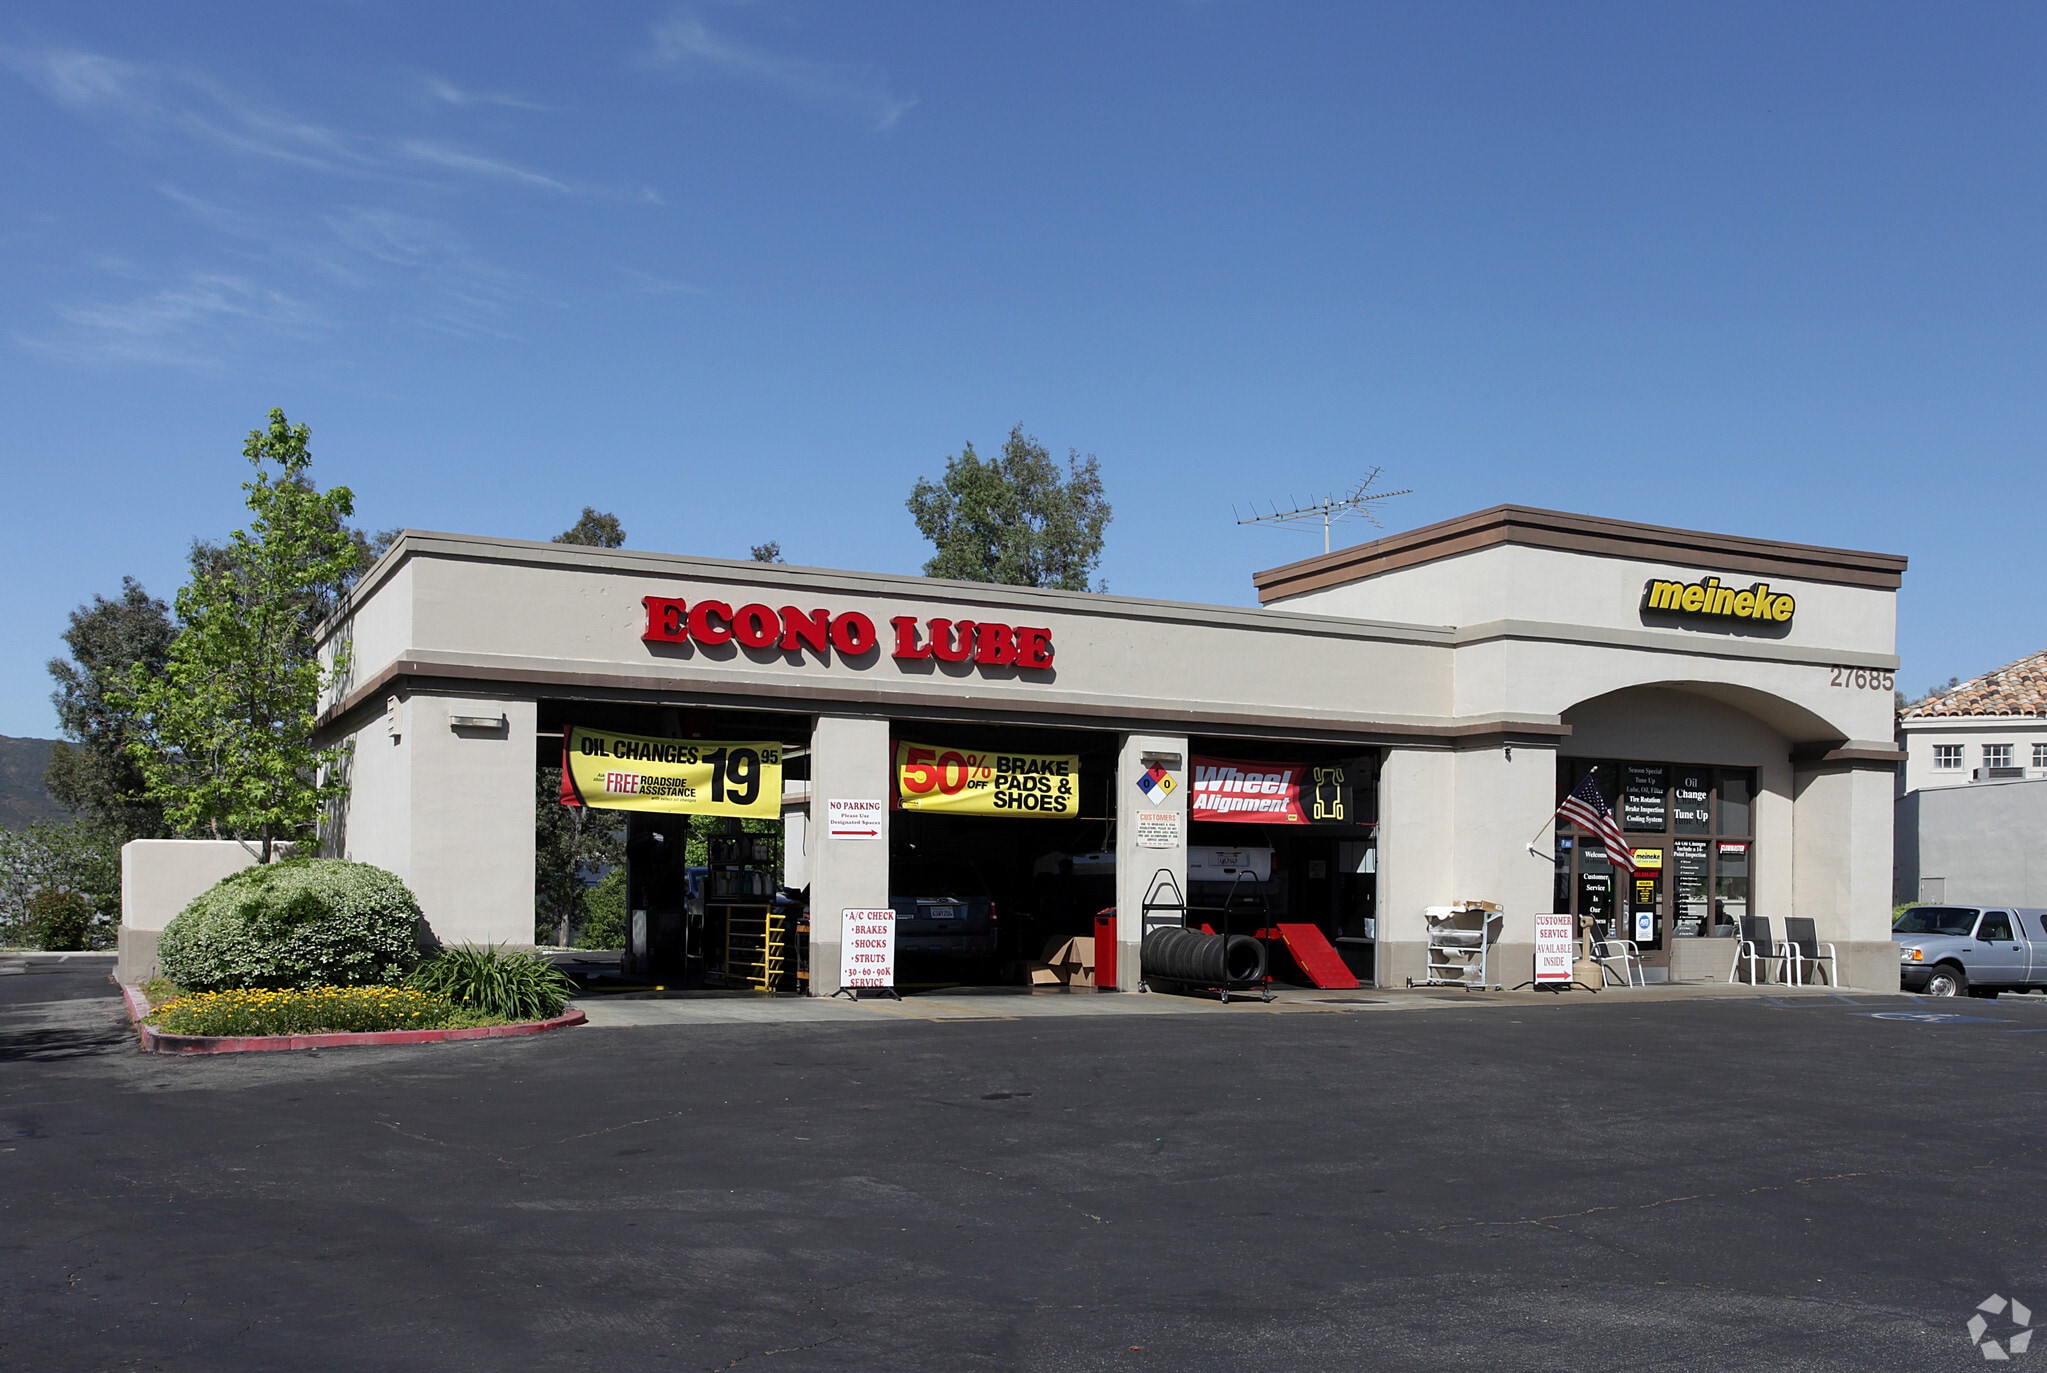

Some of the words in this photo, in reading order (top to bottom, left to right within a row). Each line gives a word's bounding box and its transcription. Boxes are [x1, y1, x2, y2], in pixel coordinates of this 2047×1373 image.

[1647, 577, 1795, 622] meineke
[642, 596, 877, 655] ECONO
[891, 616, 1054, 669] LUBE
[1830, 665, 1894, 691] 27685
[581, 737, 609, 758] OIL
[613, 739, 699, 765] CHANGES
[702, 747, 761, 805] 19
[761, 750, 779, 764] 95
[903, 747, 991, 795] 50%
[996, 756, 1070, 777] BRAKE
[1154, 767, 1159, 777] 1
[606, 772, 639, 794] FREE
[640, 775, 687, 787] ROADSIDE
[967, 780, 989, 790] OFF
[994, 774, 1051, 793] PADS
[1057, 777, 1073, 795] &
[1143, 779, 1150, 788] 0
[1164, 779, 1171, 788] 0
[1194, 765, 1293, 795] Wheel
[1648, 777, 1656, 785] Up
[1685, 778, 1698, 788] Oil
[639, 785, 696, 797] ASSISTANCE
[1676, 788, 1707, 801] Change
[1193, 793, 1290, 813] Alignment
[1629, 795, 1640, 803] Tire
[830, 801, 842, 810] NO
[843, 802, 880, 810] PARKING
[1640, 806, 1665, 814] Inspection
[1140, 813, 1176, 821] CUSTOMERS
[1626, 815, 1645, 823] Cooling
[1673, 809, 1694, 819] Tune
[1696, 810, 1709, 822] Up
[849, 911, 864, 921] A/C
[867, 911, 894, 920] CHECK
[1536, 916, 1572, 925] CUSTOMER
[855, 925, 888, 934] BRAKES
[1540, 929, 1568, 938] SERVICE
[855, 939, 887, 948] SHOCKS
[1537, 944, 1571, 953] AVAILABLE
[854, 954, 886, 963] STRUTS
[1543, 957, 1565, 966] INSIDE
[850, 978, 884, 987] SERVICE
